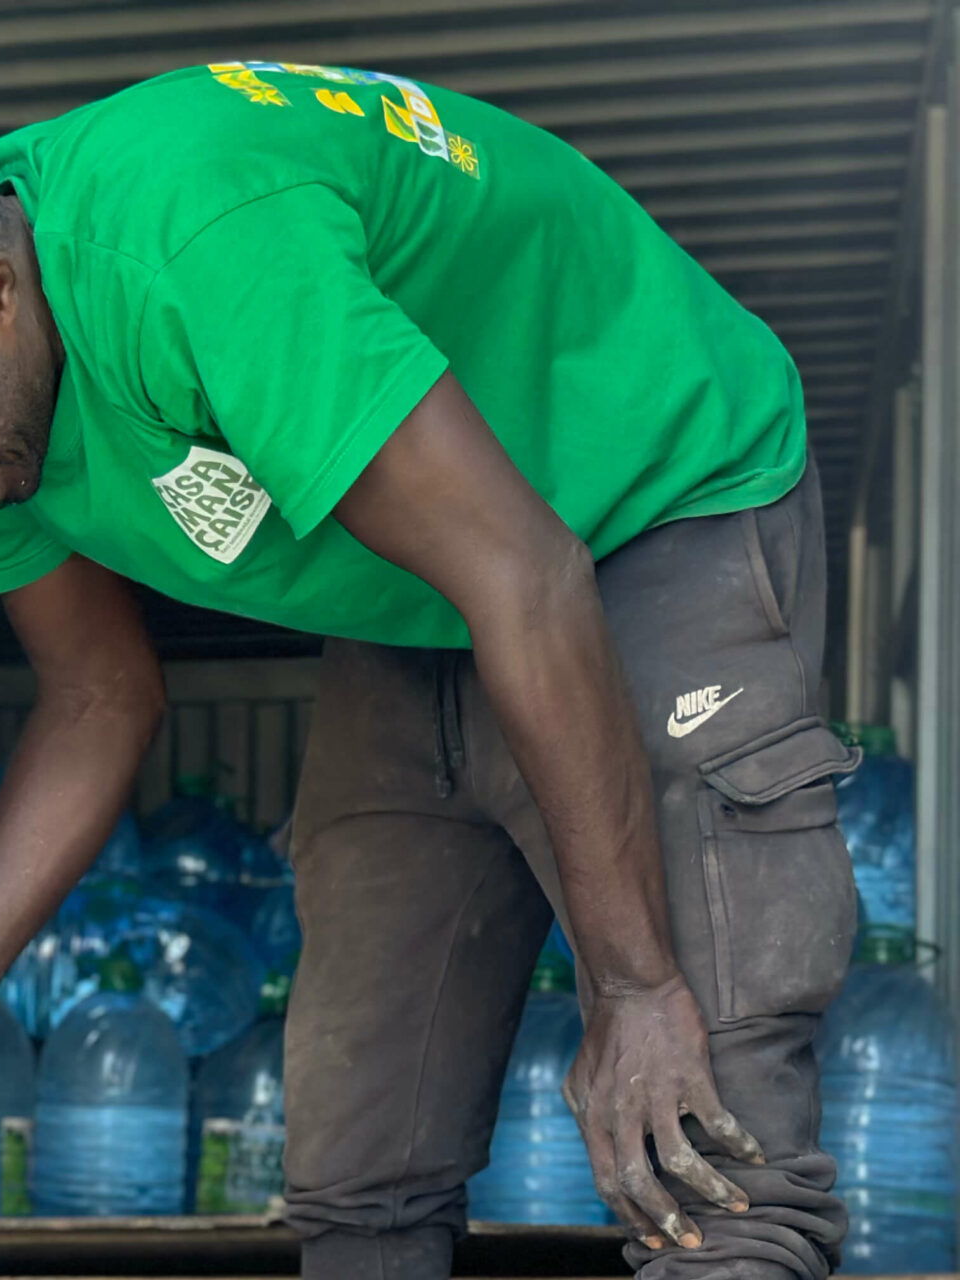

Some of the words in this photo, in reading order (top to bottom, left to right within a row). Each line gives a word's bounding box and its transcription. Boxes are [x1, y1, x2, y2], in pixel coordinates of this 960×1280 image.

[156, 460, 221, 509] CASA
[173, 464, 242, 533] MAN
[676, 685, 722, 720] NIKE
